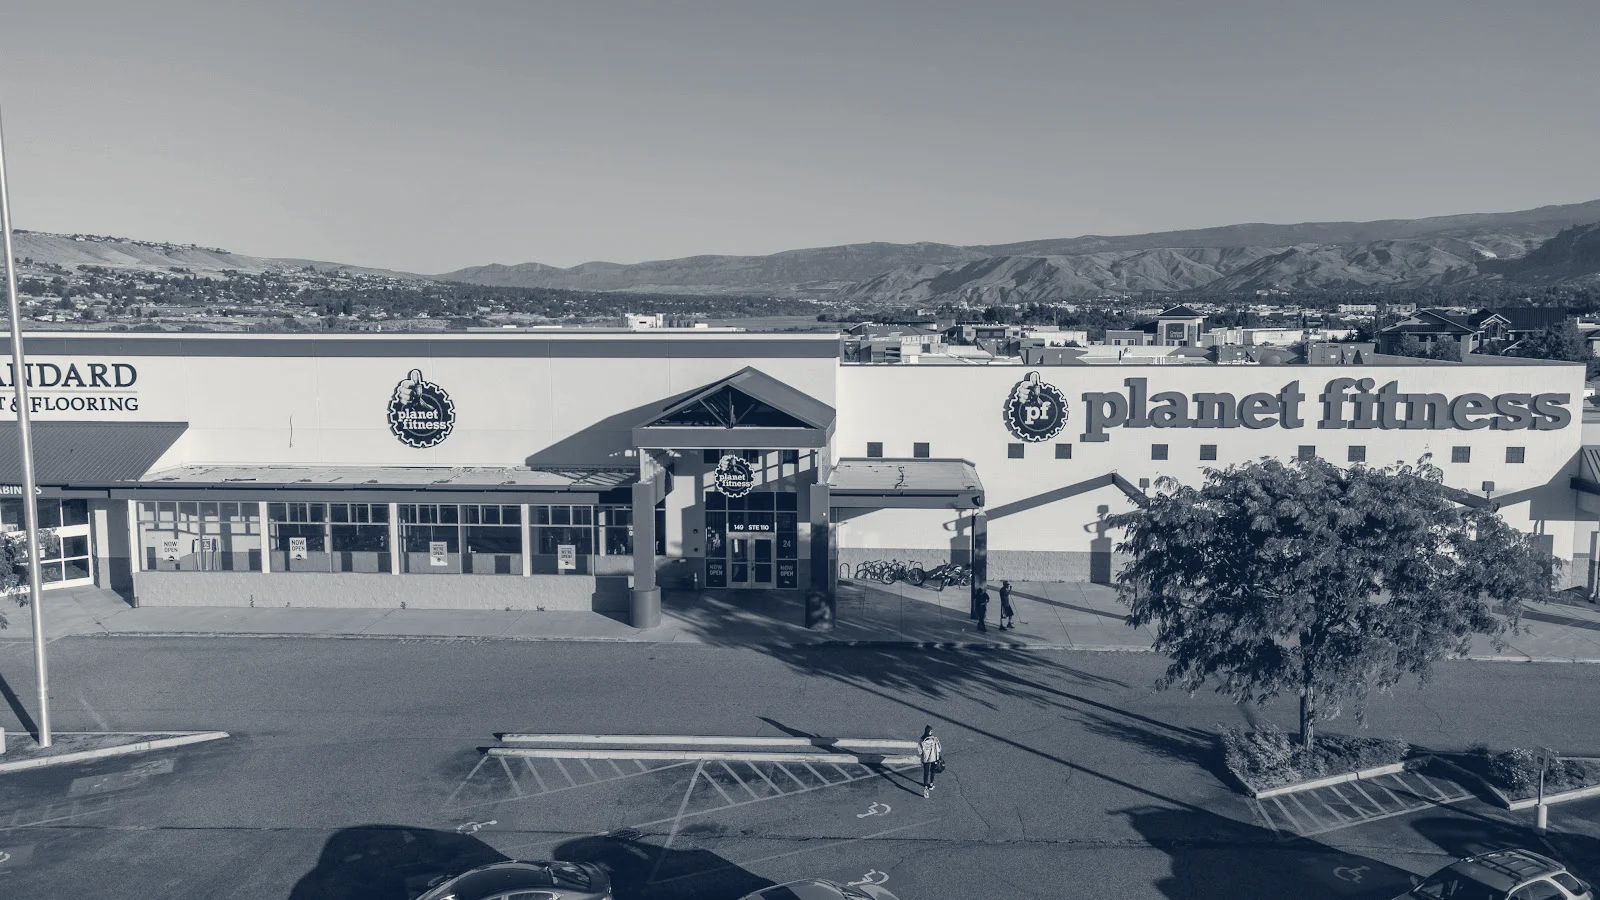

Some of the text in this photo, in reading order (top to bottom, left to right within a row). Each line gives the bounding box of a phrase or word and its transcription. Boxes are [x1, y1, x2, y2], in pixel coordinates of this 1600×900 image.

[30, 396, 139, 413] FLOORING
[1080, 377, 1571, 442] planet fitness
[397, 408, 439, 422] planet
[1025, 401, 1052, 425] pf
[402, 418, 447, 430] fitness
[719, 472, 746, 481] planet
[722, 479, 751, 487] fitness
